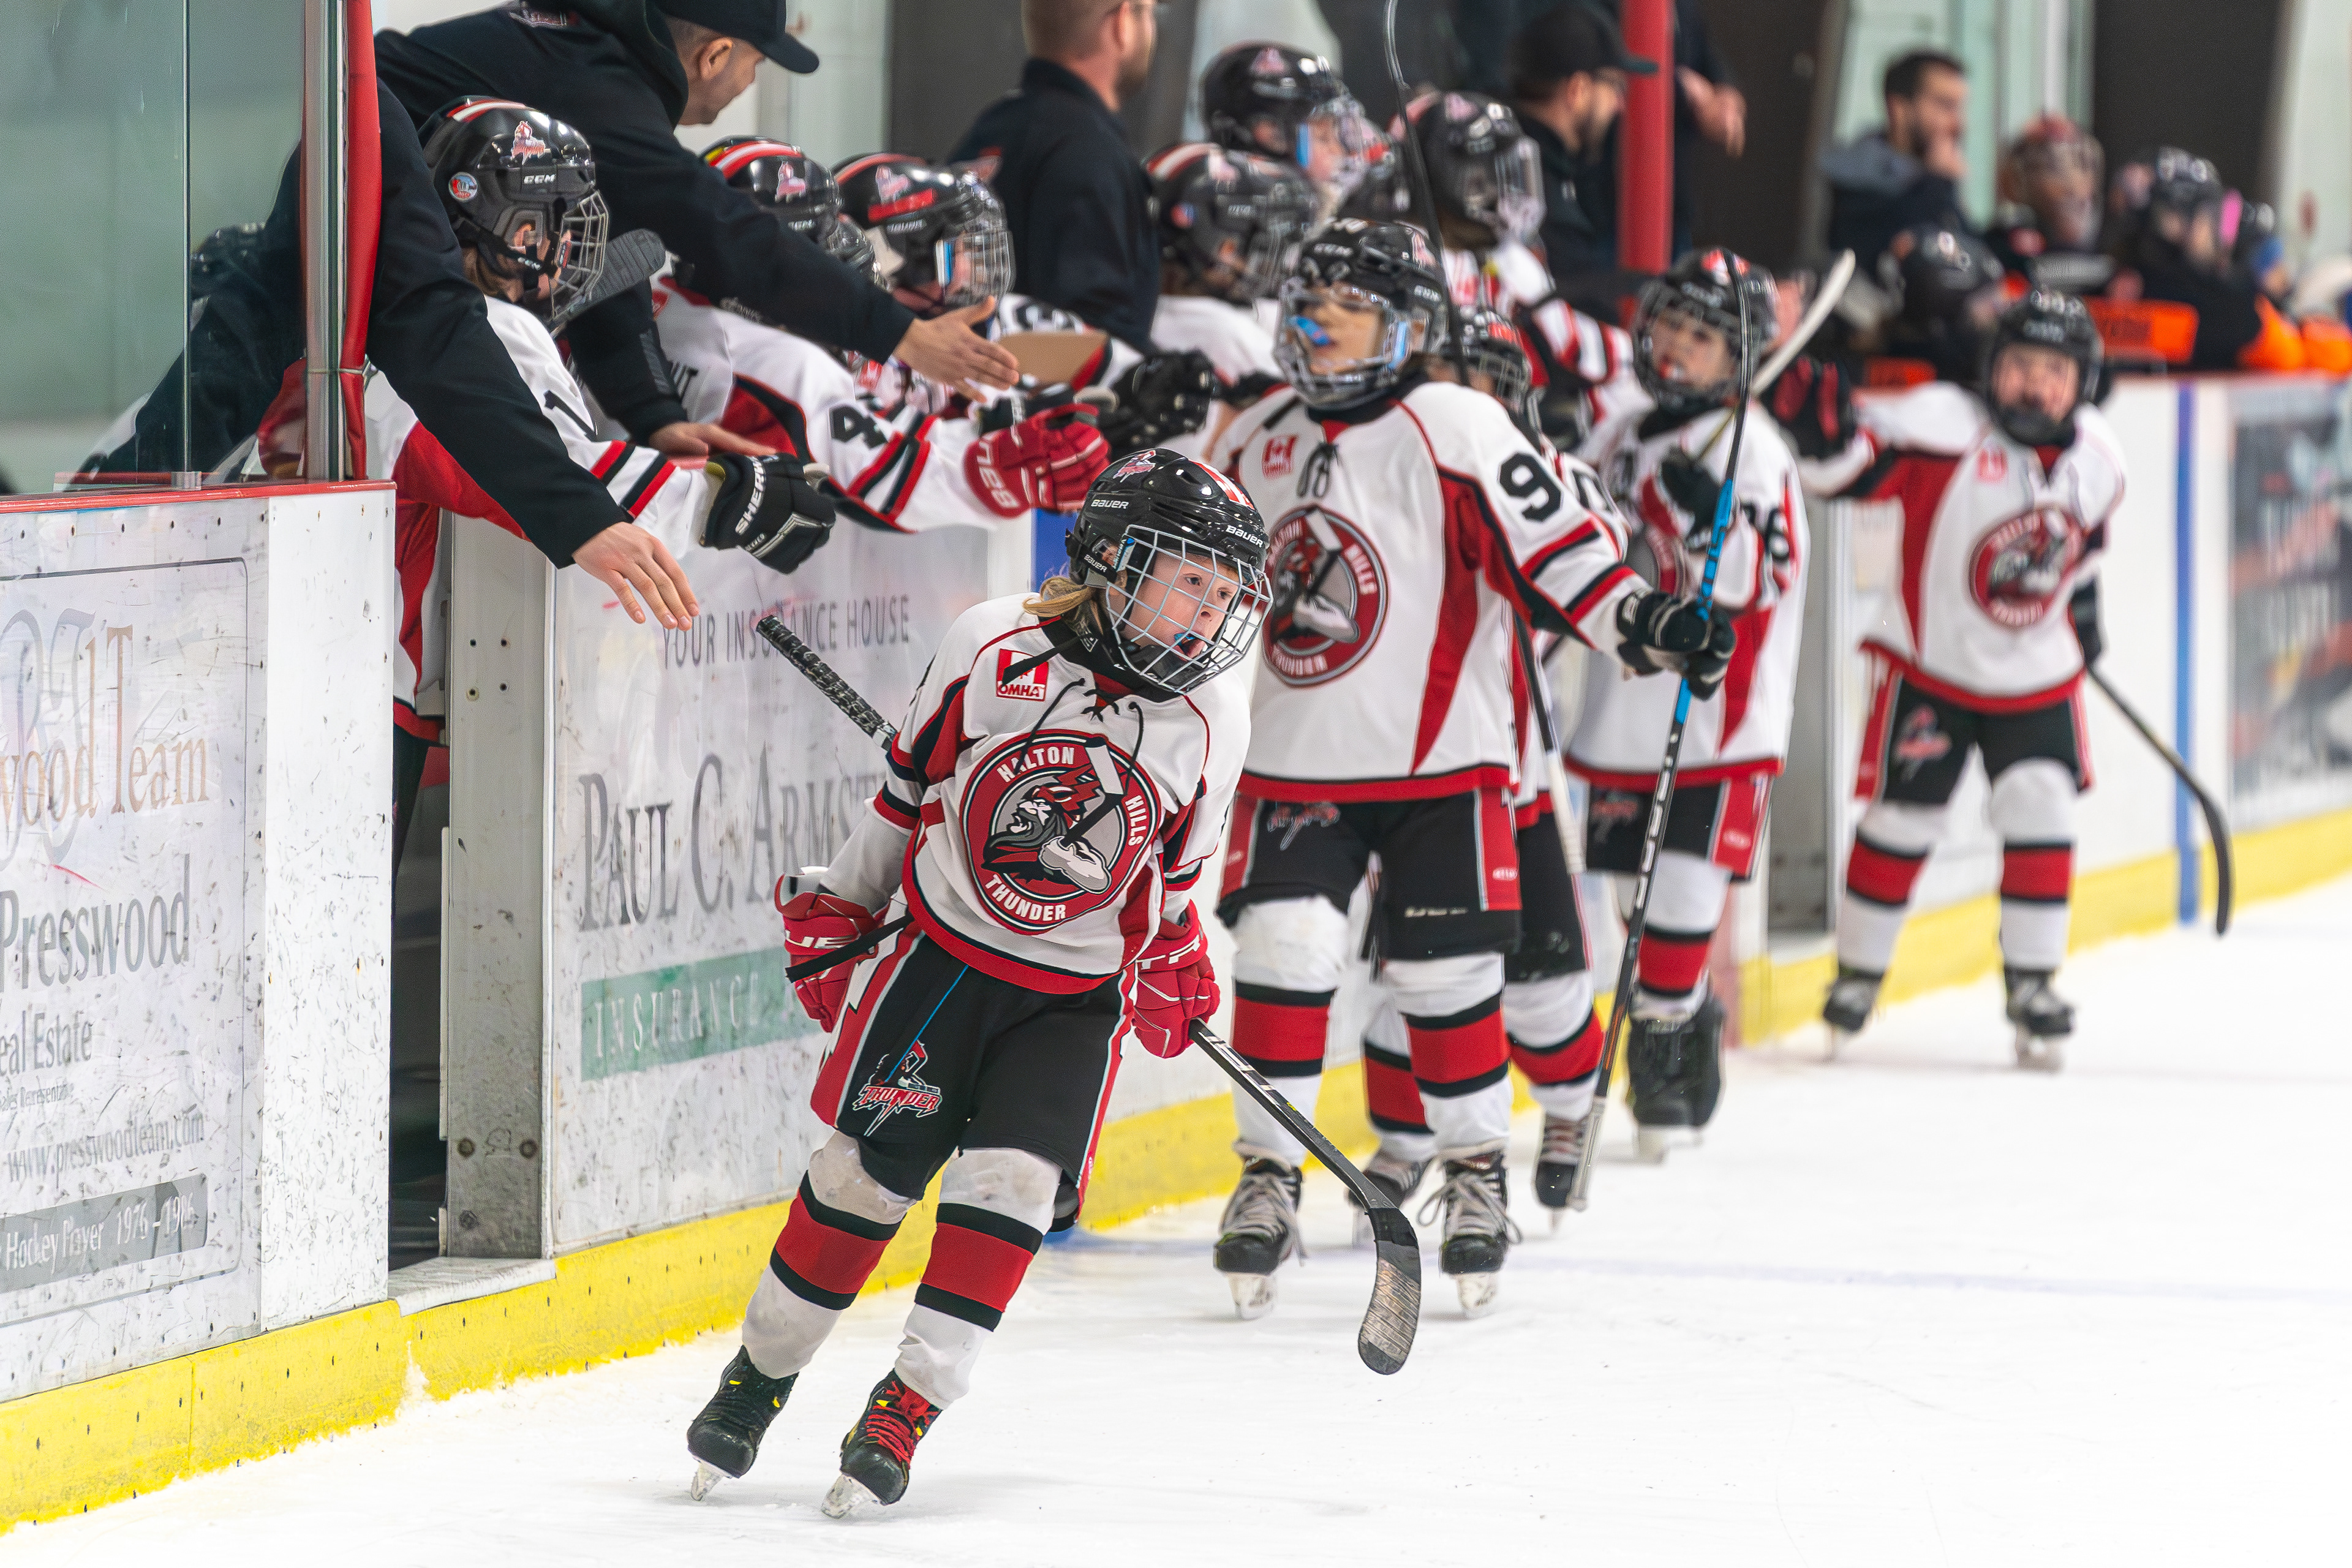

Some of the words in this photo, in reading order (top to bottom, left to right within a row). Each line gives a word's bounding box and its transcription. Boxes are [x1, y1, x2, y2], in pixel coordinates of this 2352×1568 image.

[524, 173, 557, 184] CCM
[1499, 451, 1564, 522] 9
[663, 614, 715, 669] YOUR
[846, 594, 910, 648] HOUSE
[105, 624, 209, 813] Team
[998, 684, 1039, 697] OMHA
[997, 746, 1074, 783] HALTON
[1125, 795, 1144, 847] HILLS
[578, 773, 679, 932] PAUL
[0, 853, 190, 992] Presswood
[984, 873, 1066, 921] THUNDER
[34, 1011, 92, 1069] Estate
[858, 1085, 941, 1114] THUNDER
